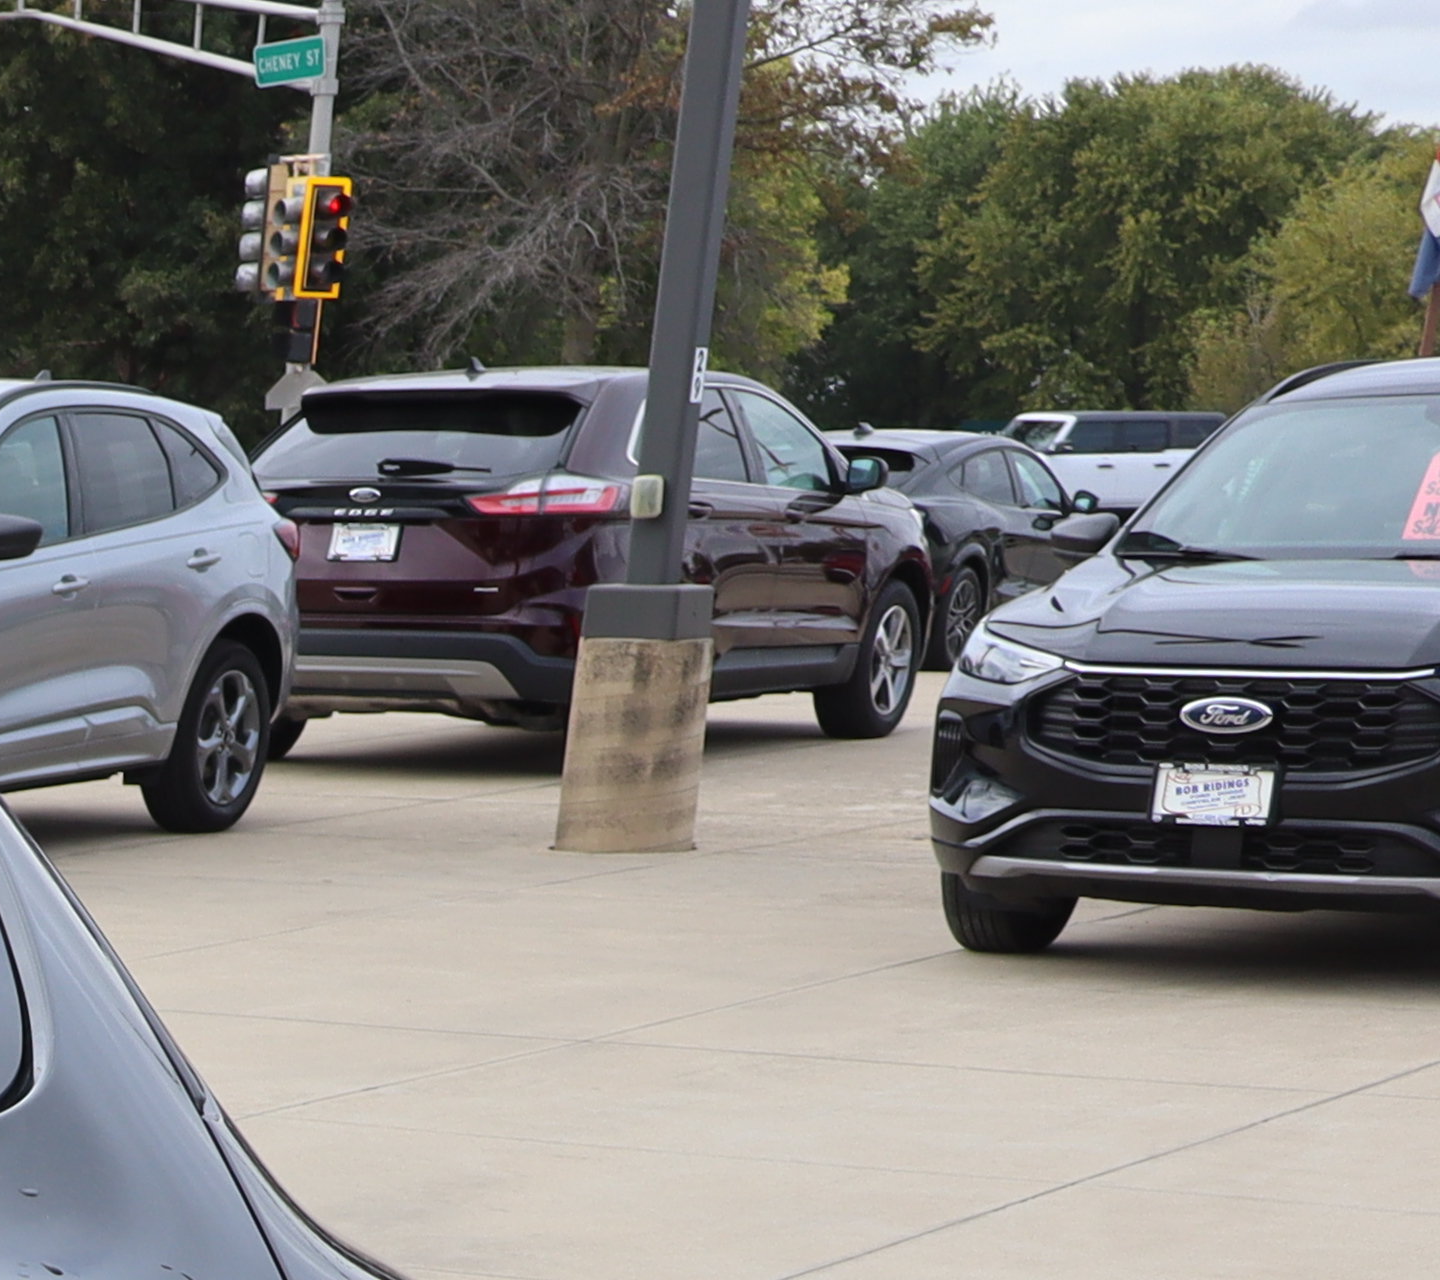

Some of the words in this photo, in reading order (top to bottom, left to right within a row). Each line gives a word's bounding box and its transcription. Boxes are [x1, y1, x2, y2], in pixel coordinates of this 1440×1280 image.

[259, 51, 301, 74] CHENEY
[306, 48, 320, 67] ST
[694, 350, 704, 399] 29
[1200, 704, 1251, 725] Ford
[1175, 785, 1199, 796] BOB
[1203, 778, 1250, 792] RIDINGS
